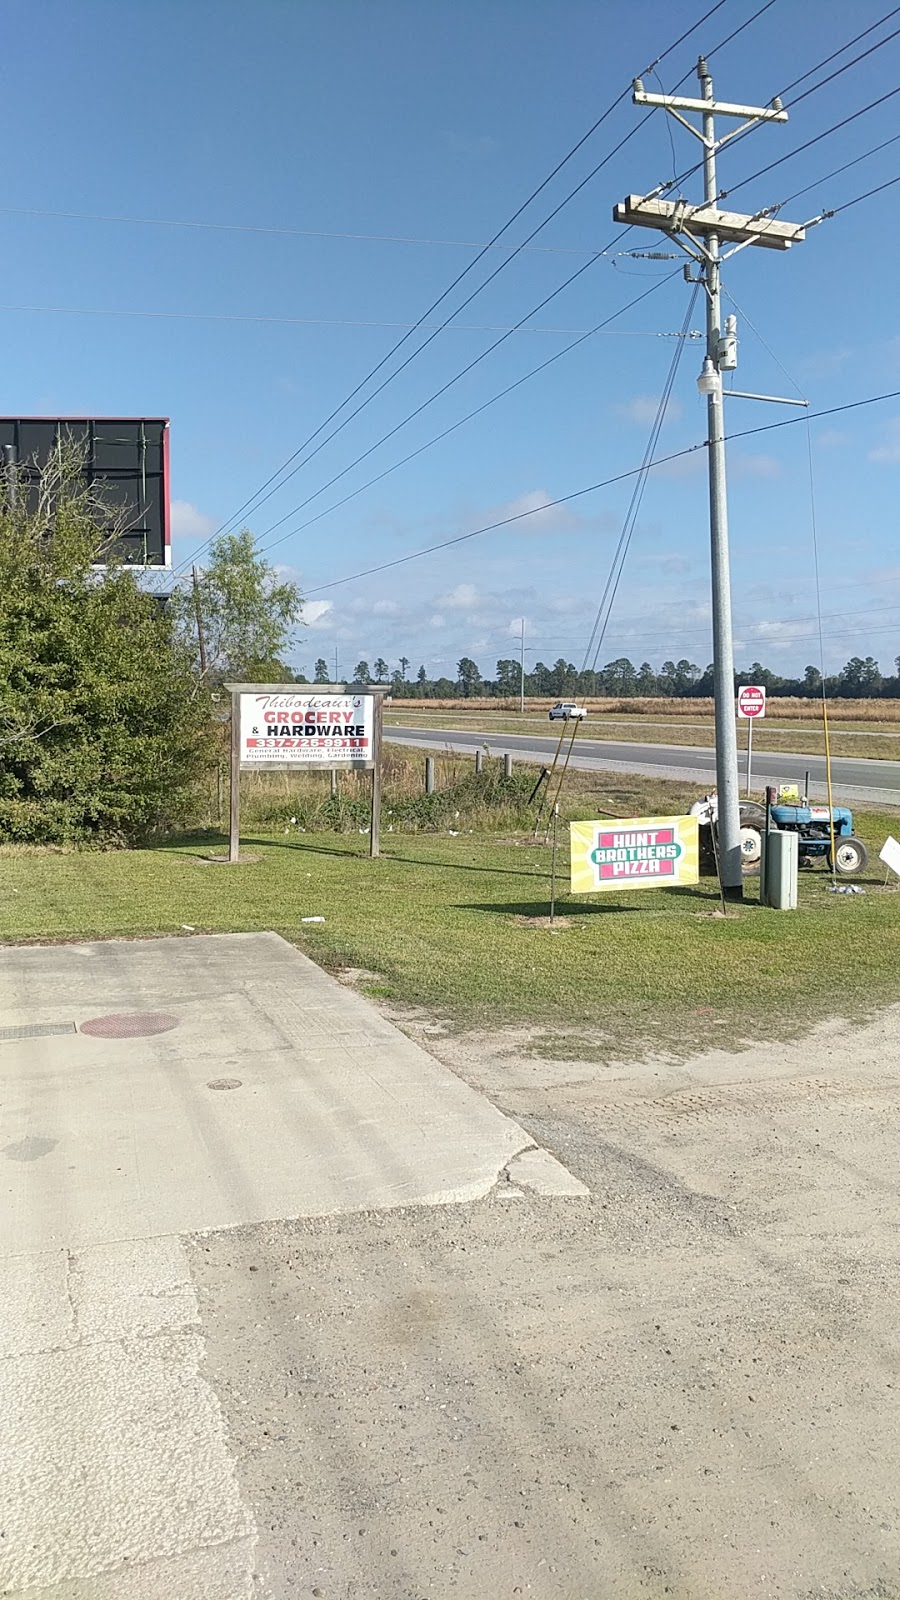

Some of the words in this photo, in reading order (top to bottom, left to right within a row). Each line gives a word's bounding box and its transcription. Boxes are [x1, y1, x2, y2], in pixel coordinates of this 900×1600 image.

[255, 695, 363, 710] Thibodeaux's
[264, 711, 354, 723] GROCERY
[252, 726, 260, 734] &
[267, 725, 365, 736] HARDWARE
[256, 738, 361, 747] 337-725-9911
[613, 832, 658, 848] HUNT
[595, 845, 677, 863] BROTHERS
[612, 859, 660, 876] PIZZA
